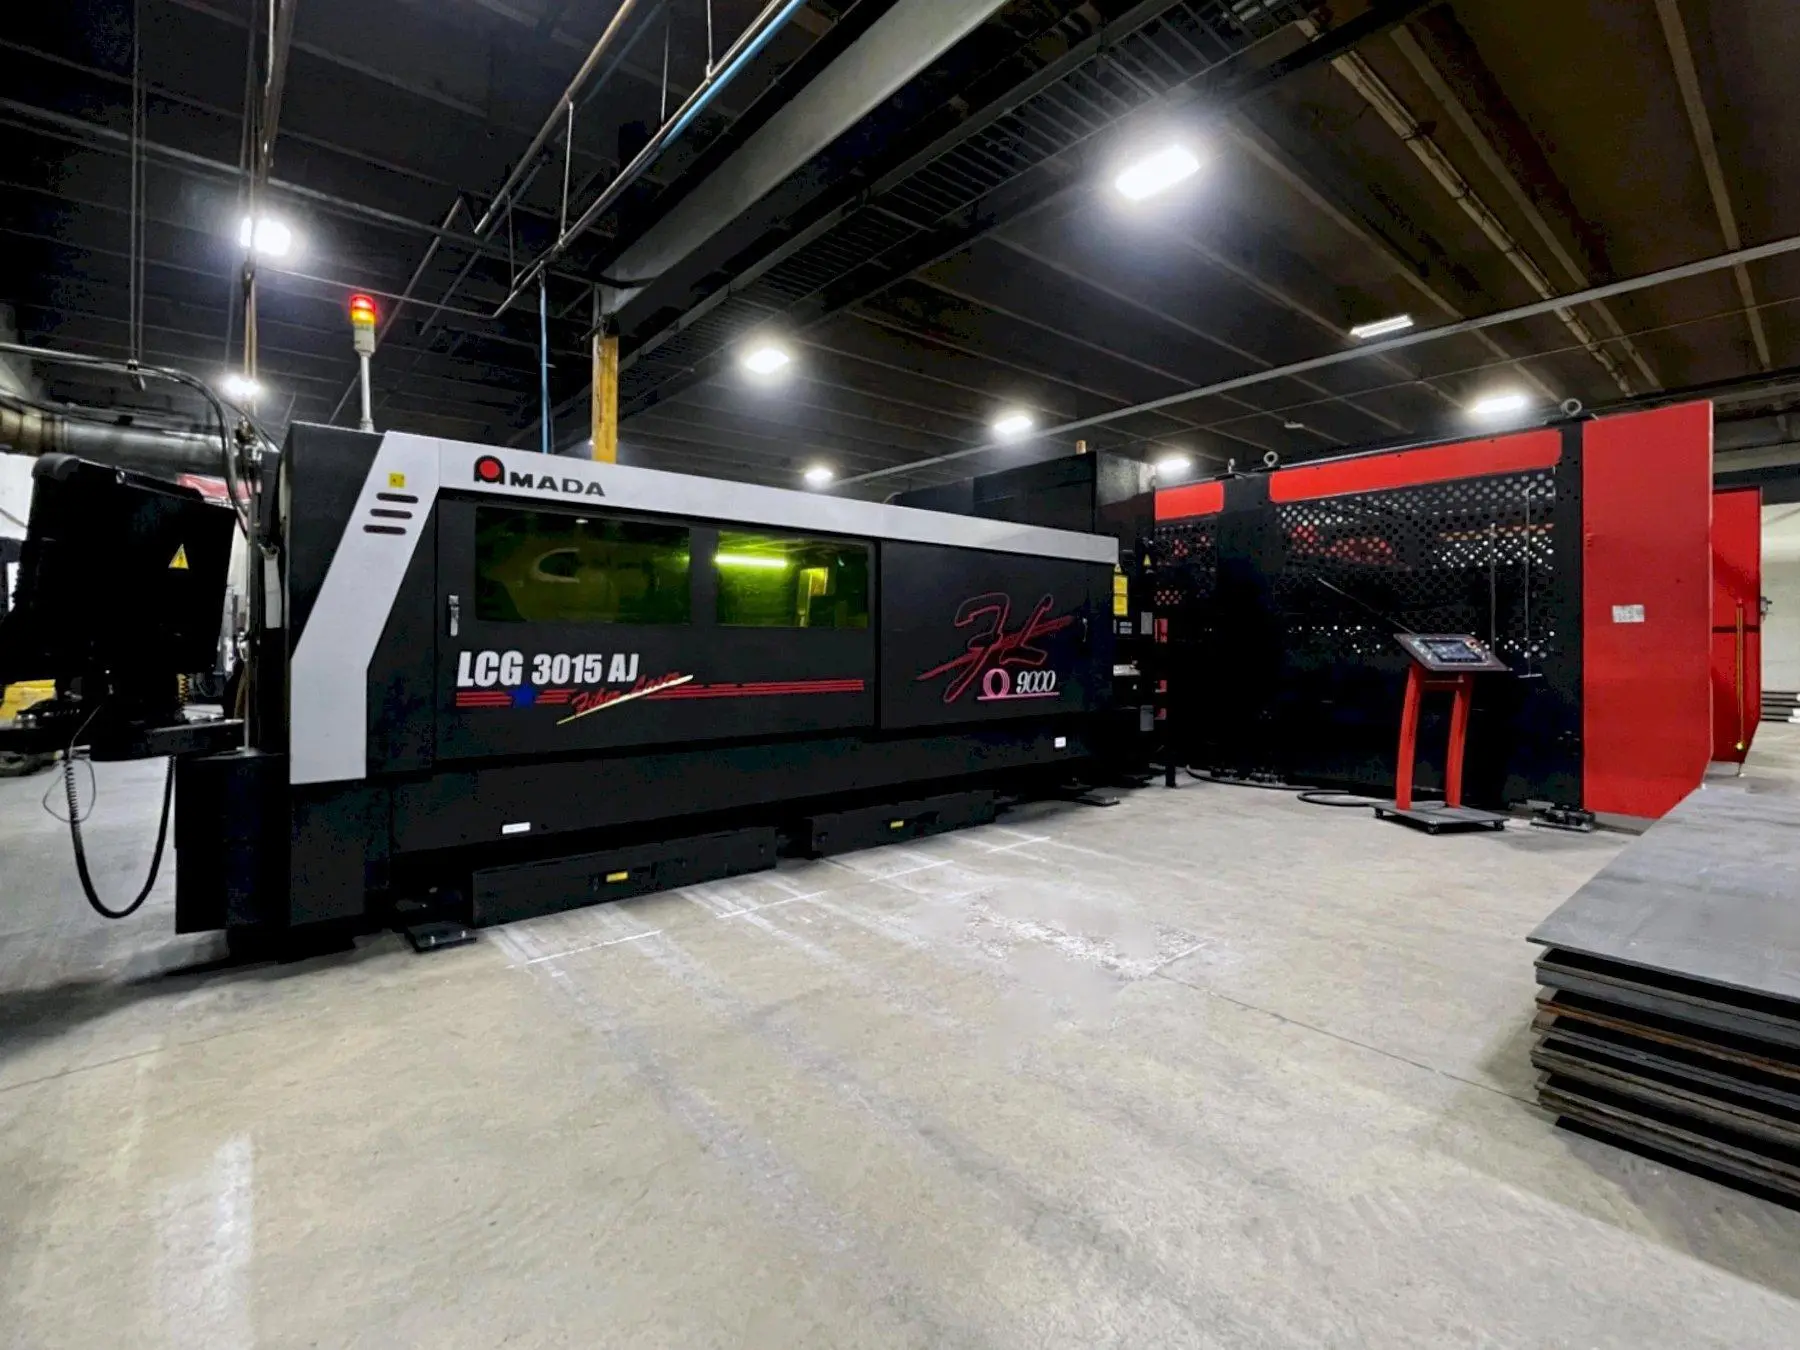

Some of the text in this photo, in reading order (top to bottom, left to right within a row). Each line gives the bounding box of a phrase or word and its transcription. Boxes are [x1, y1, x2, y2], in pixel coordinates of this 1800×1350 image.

[473, 455, 606, 498] AMADA
[457, 650, 639, 687] LCG 3015 AJ
[1015, 670, 1057, 694] 9000
